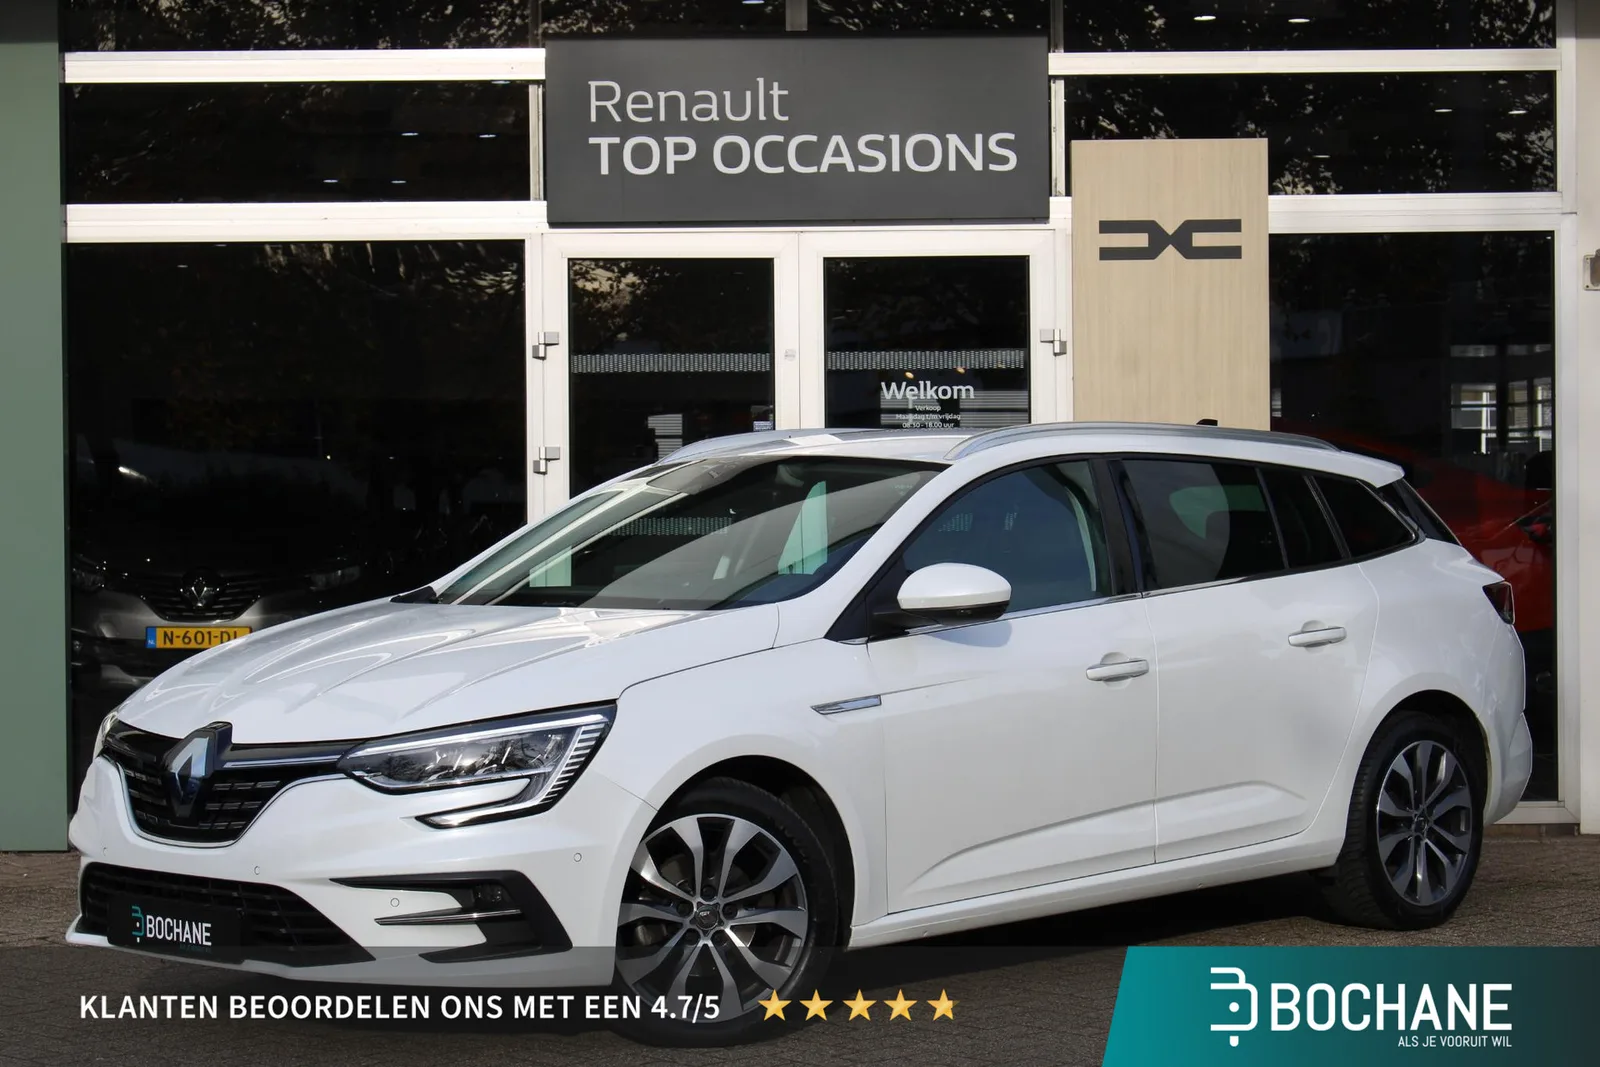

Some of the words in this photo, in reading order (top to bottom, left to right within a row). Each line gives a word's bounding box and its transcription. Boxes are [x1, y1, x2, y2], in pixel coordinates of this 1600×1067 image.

[588, 77, 789, 123] Renault
[588, 135, 697, 175] TOP
[712, 132, 1018, 174] OCCASIONS
[880, 380, 975, 400] Welkom
[938, 413, 961, 421] vrijdag
[146, 915, 212, 946] BOCHANE
